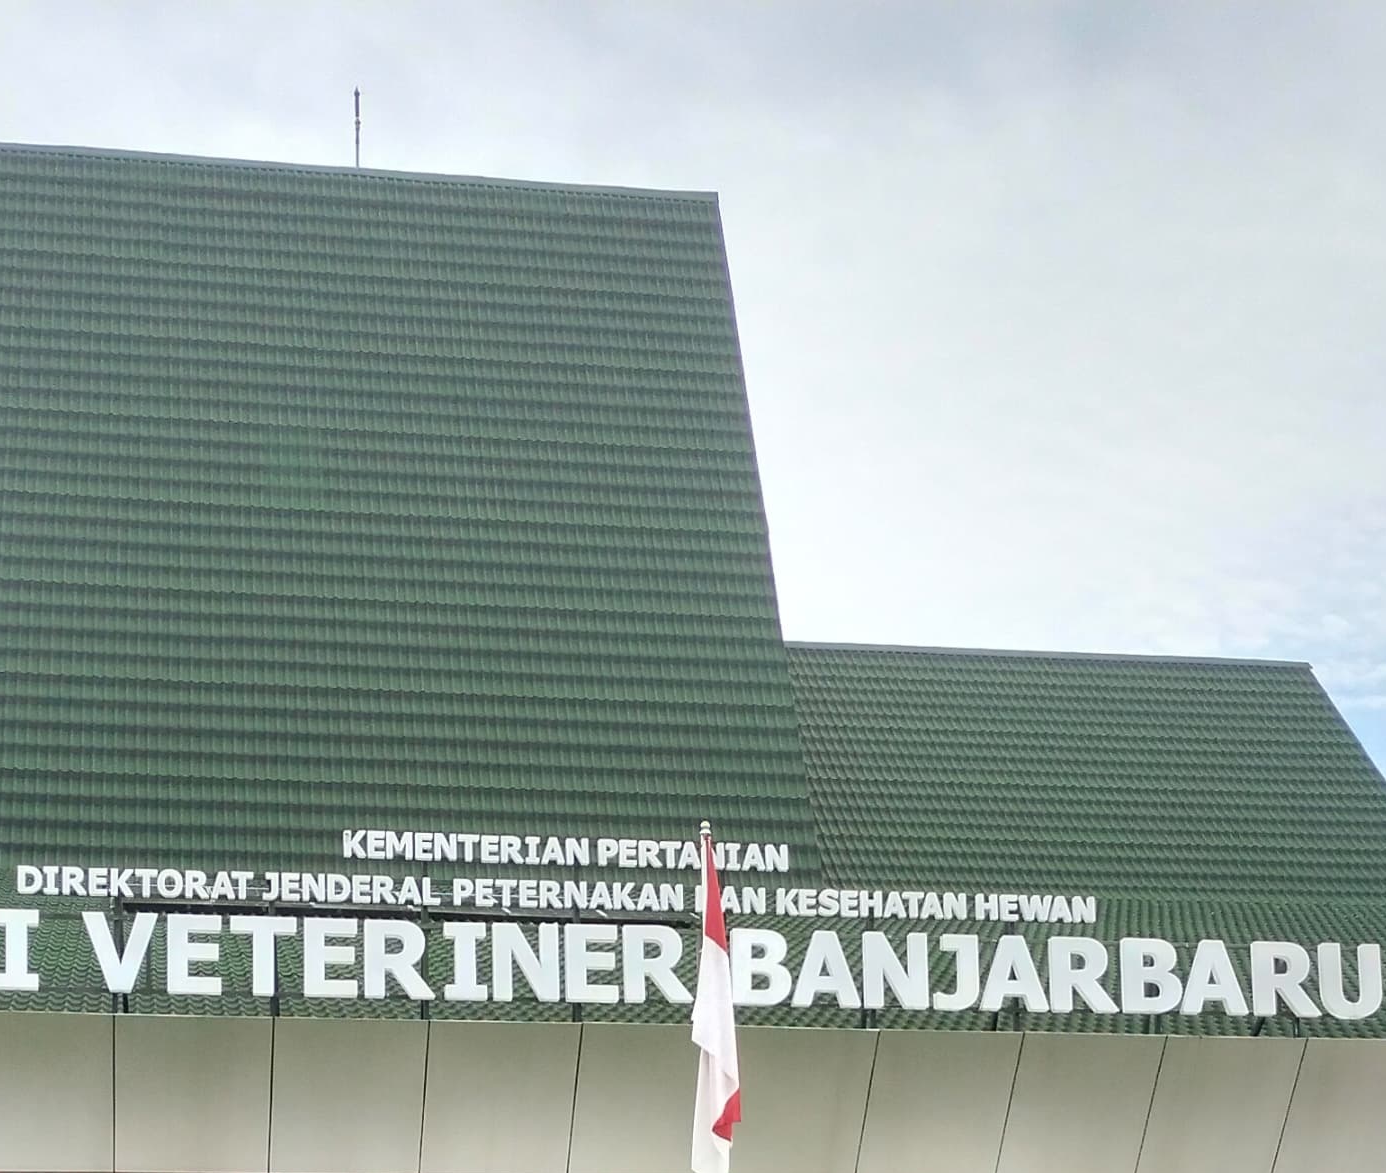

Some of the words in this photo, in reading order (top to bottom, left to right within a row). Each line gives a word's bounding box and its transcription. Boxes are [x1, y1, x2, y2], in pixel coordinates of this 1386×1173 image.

[342, 829, 591, 868] KEMENTERIAN
[597, 838, 790, 873] PERTANIAN
[16, 864, 256, 901] DIREKTORAT
[262, 871, 443, 907] JENDERAL
[451, 877, 685, 913] PETERNAKAN
[775, 887, 969, 922] KESEHATAN
[974, 892, 1097, 925] HEWAN
[81, 911, 696, 1005] VETERINER
[729, 927, 1384, 1021] BANJARBARU
